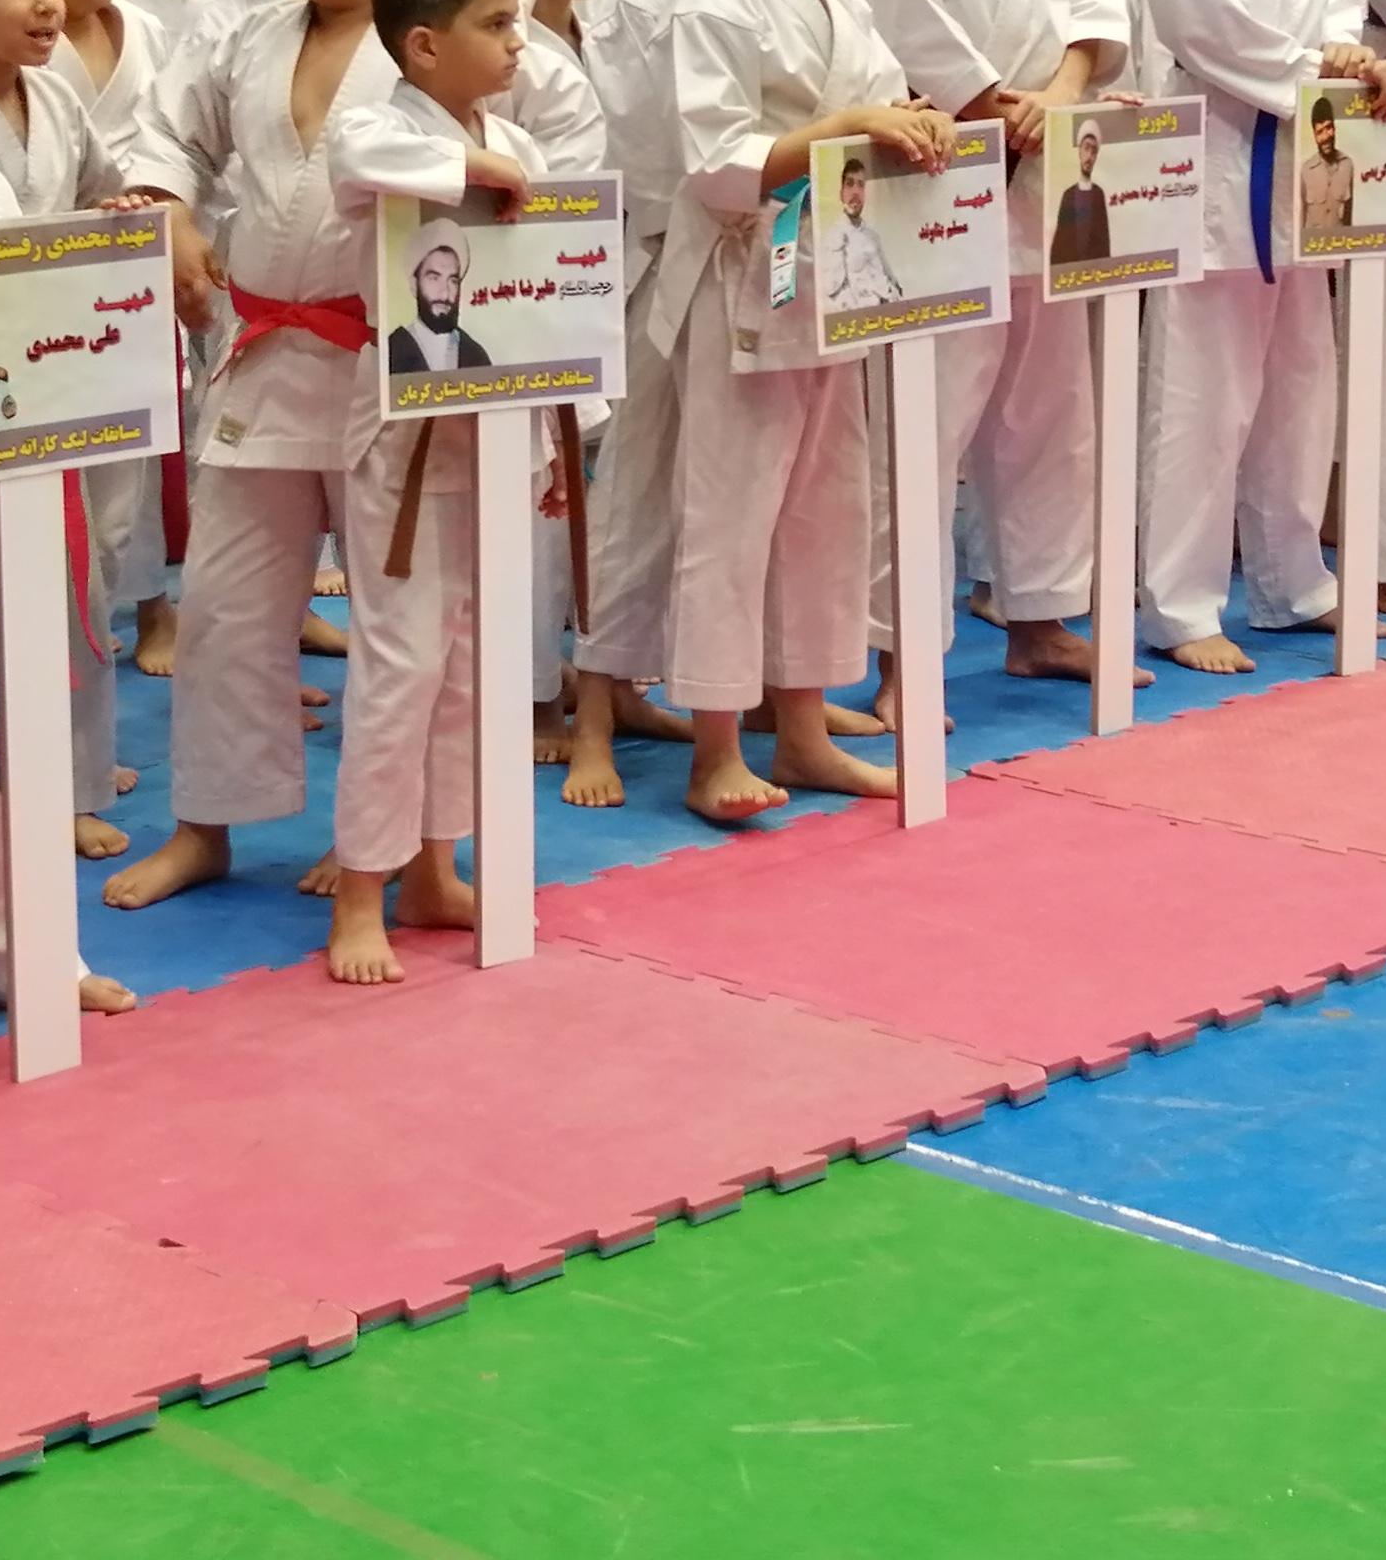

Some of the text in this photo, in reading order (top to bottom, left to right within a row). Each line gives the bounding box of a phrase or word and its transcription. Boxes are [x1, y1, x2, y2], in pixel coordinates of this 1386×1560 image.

[562, 189, 599, 216] شهید
[46, 232, 111, 260] محمدی
[116, 221, 157, 248] شهید
[557, 245, 607, 268] شهید
[94, 287, 154, 312] شهید
[27, 324, 120, 363] علی محمدی
